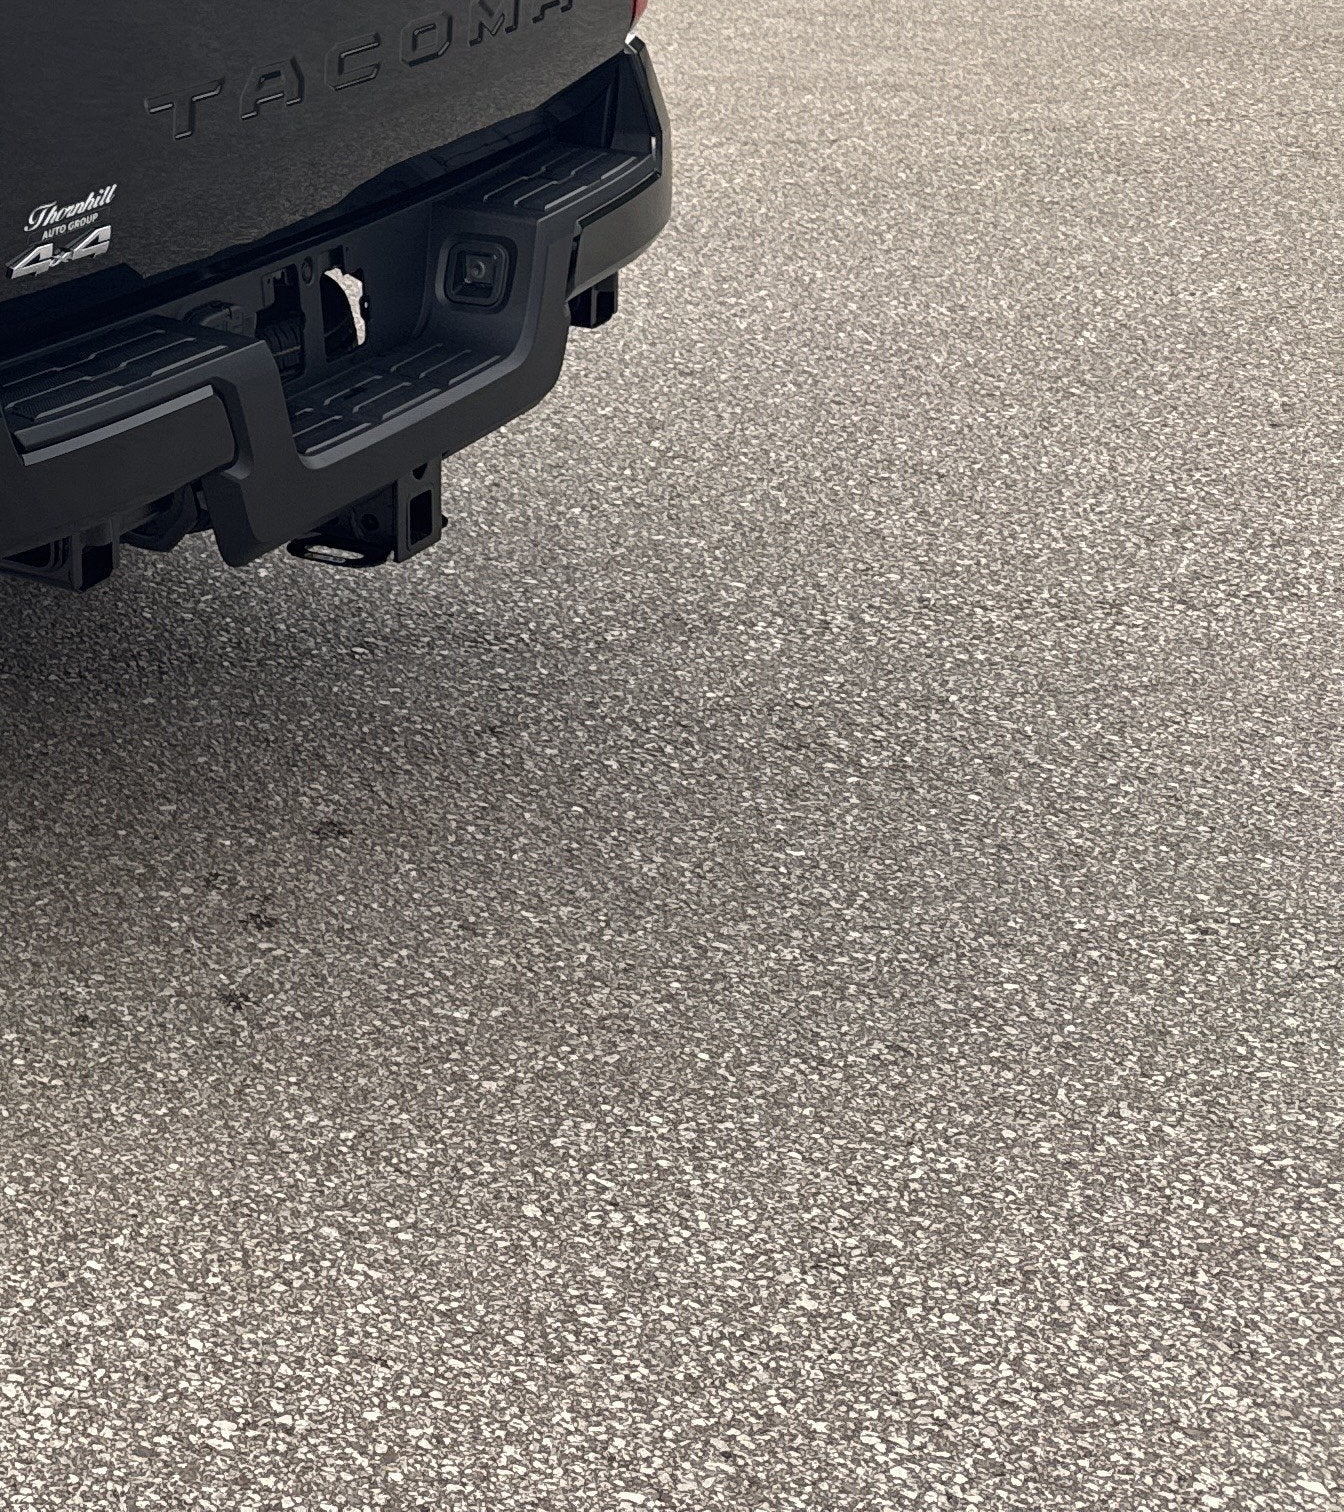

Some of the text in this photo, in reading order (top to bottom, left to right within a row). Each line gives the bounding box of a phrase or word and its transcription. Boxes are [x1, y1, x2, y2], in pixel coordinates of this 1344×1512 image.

[23, 183, 118, 232] Thornhill
[41, 212, 99, 241] AUTO GROUP
